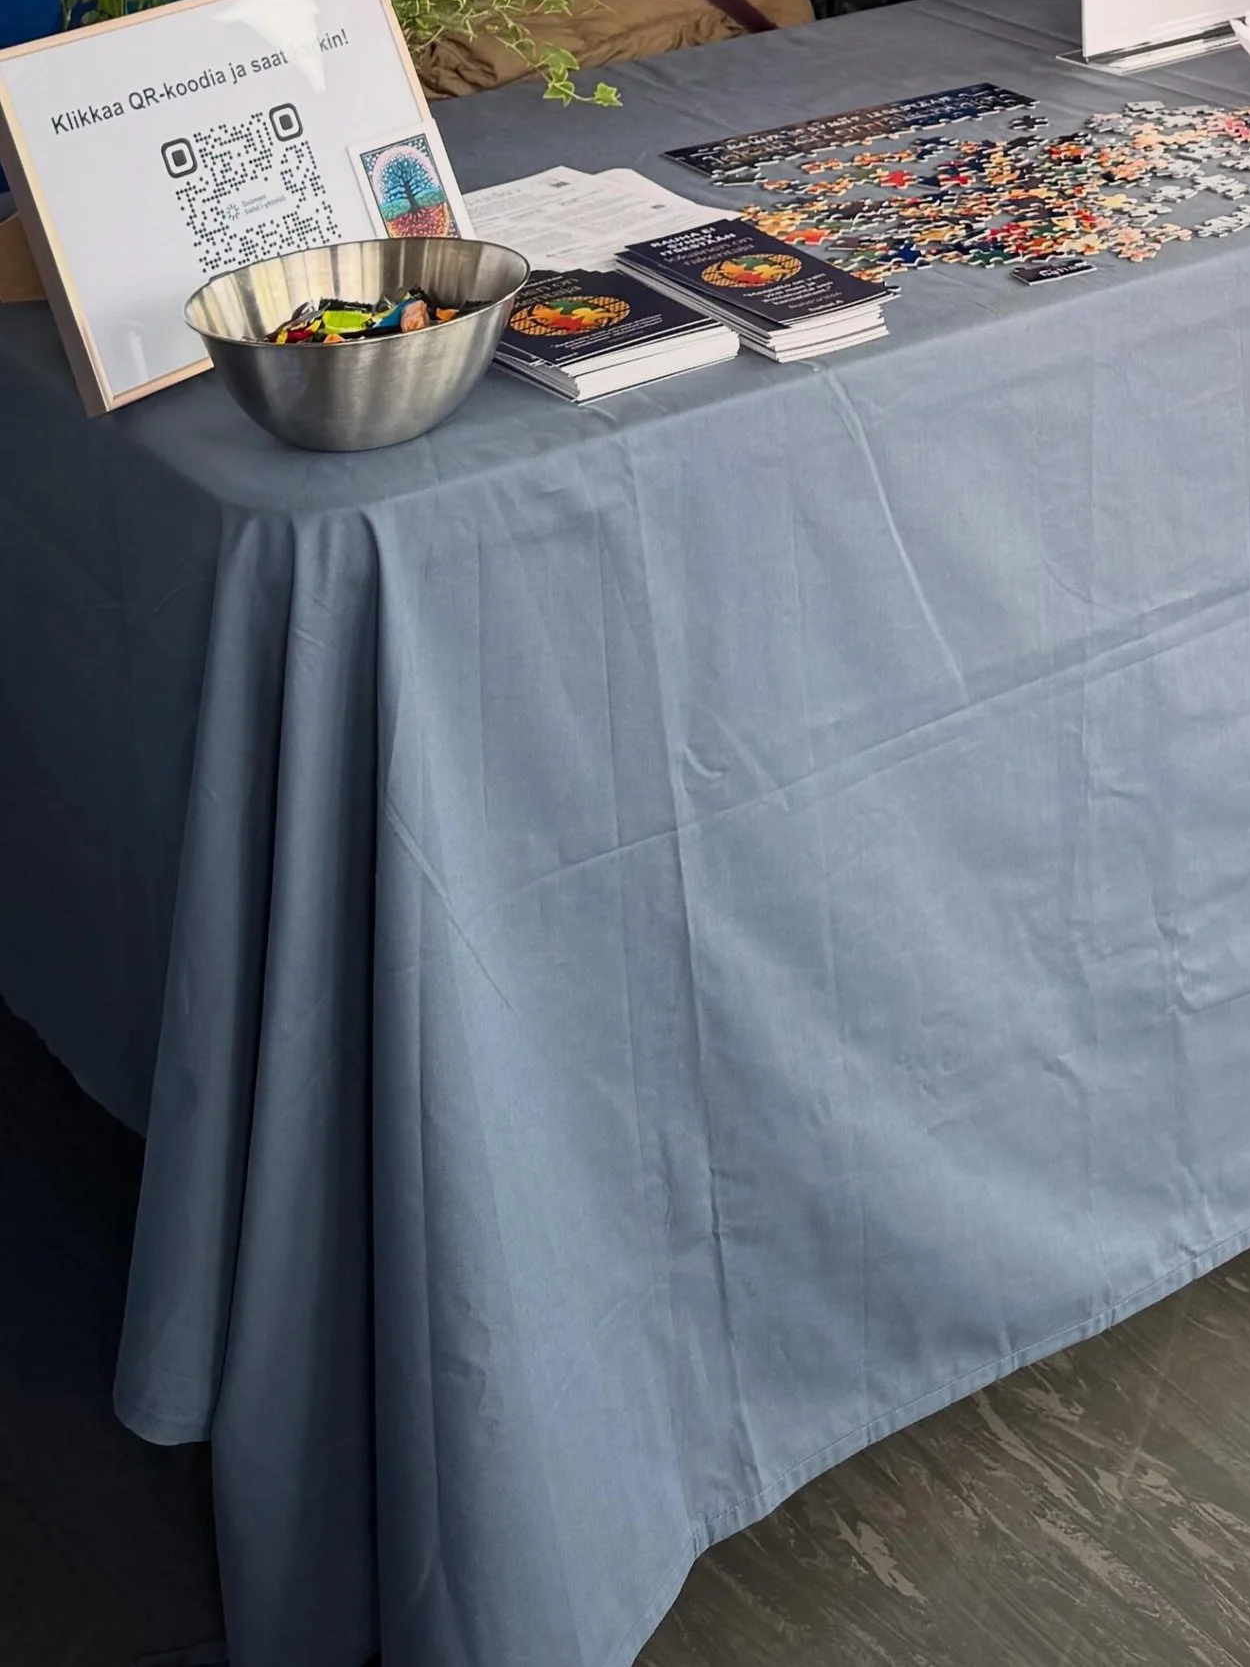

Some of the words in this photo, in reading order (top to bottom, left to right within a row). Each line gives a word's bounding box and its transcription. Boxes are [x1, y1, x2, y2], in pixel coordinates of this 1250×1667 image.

[51, 101, 125, 136] Klikkaa
[128, 70, 226, 111] QR-koodia
[230, 62, 247, 84] ja
[251, 50, 289, 74] saat
